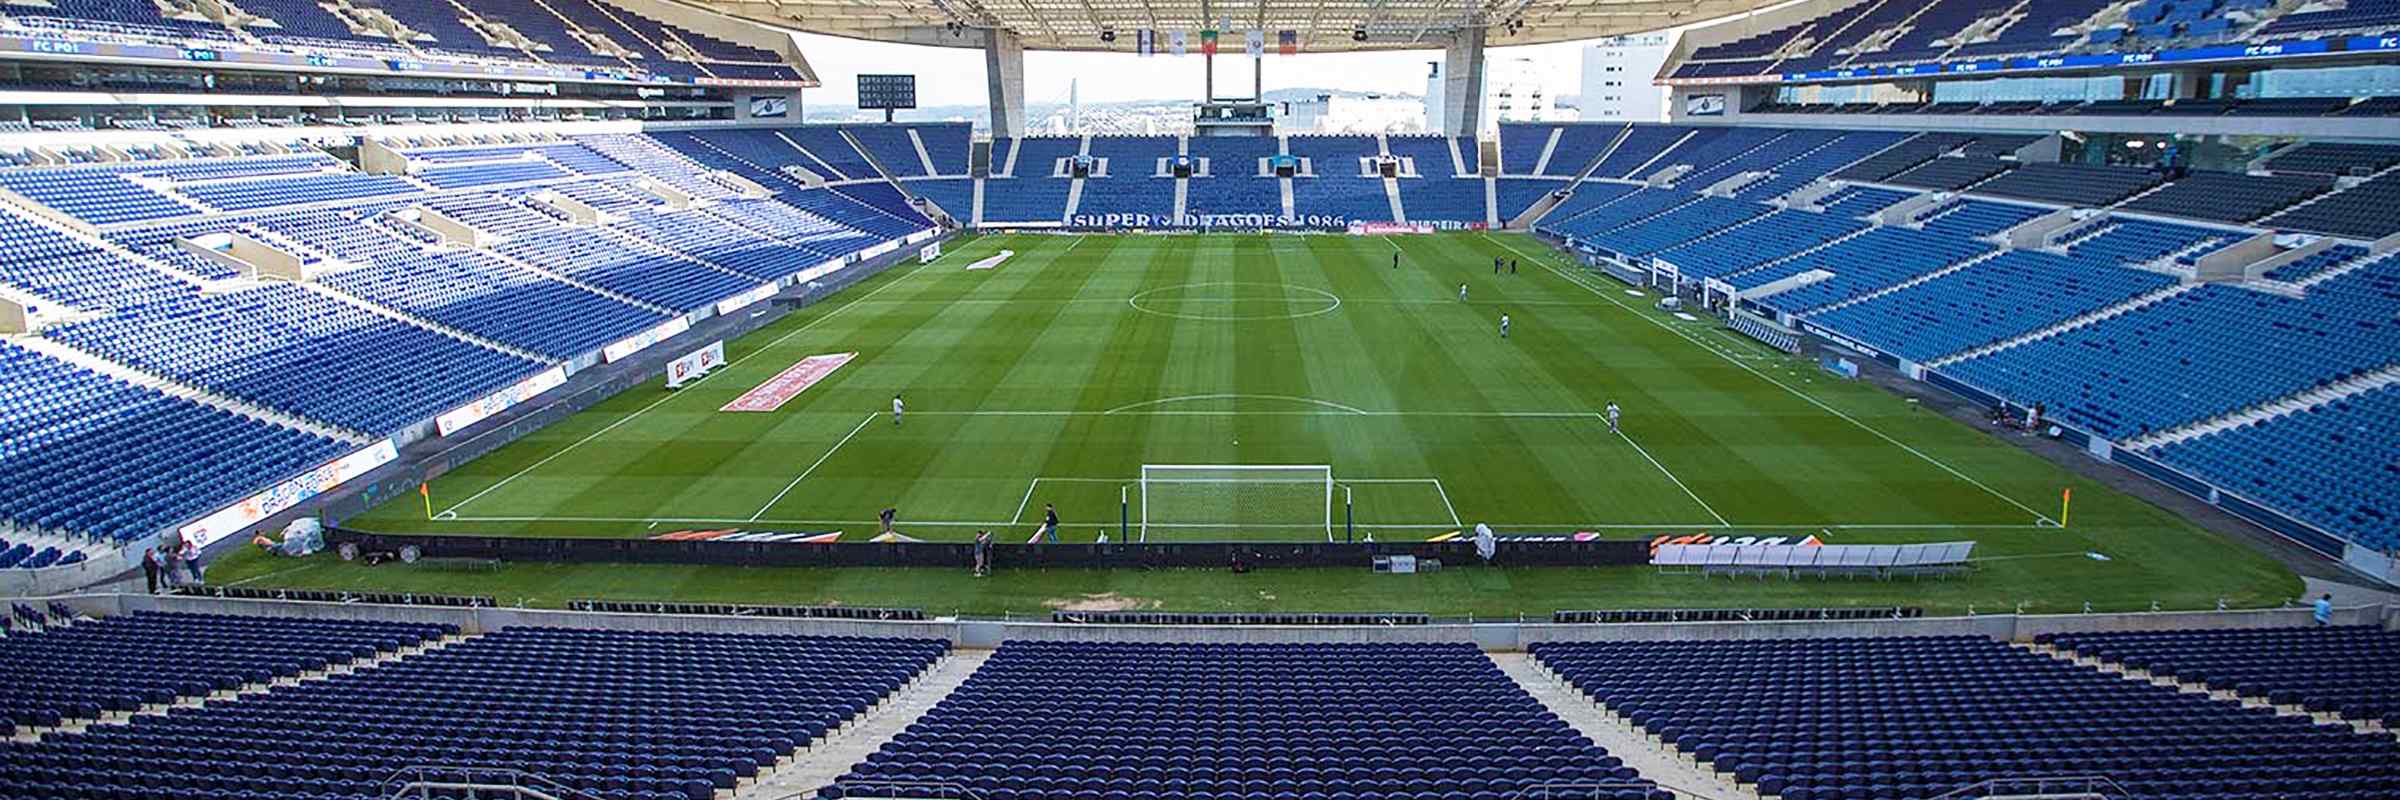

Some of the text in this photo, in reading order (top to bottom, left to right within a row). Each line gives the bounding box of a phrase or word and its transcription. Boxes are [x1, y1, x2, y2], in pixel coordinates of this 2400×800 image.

[33, 41, 51, 52] FC
[2380, 37, 2398, 48] FC
[1073, 213, 1151, 227] SUPER
[1296, 214, 1345, 227] 1986
